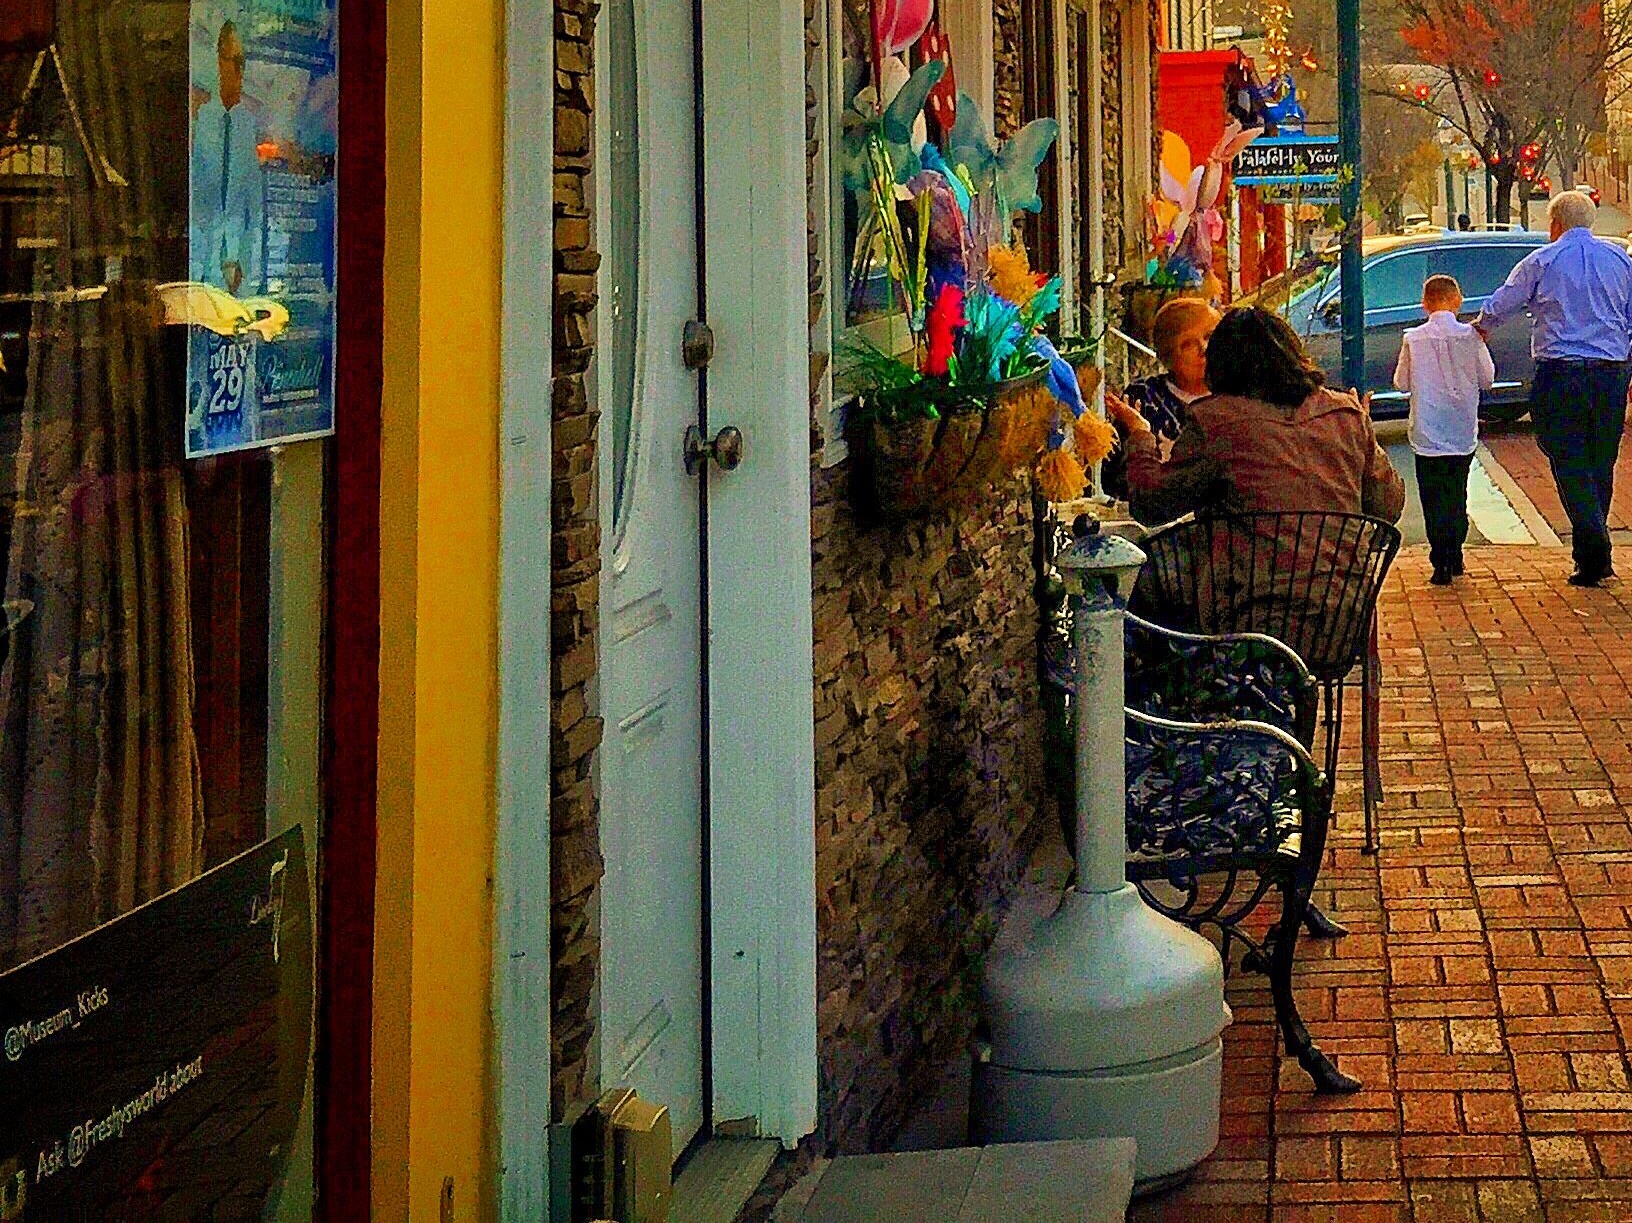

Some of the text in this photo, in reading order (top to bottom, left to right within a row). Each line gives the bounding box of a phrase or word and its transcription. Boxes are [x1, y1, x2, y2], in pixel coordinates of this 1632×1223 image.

[1306, 148, 1340, 165] Your
[209, 343, 249, 369] MAY
[208, 367, 244, 414] 29
[36, 1140, 65, 1184] Ask
[169, 1055, 203, 1095] about
